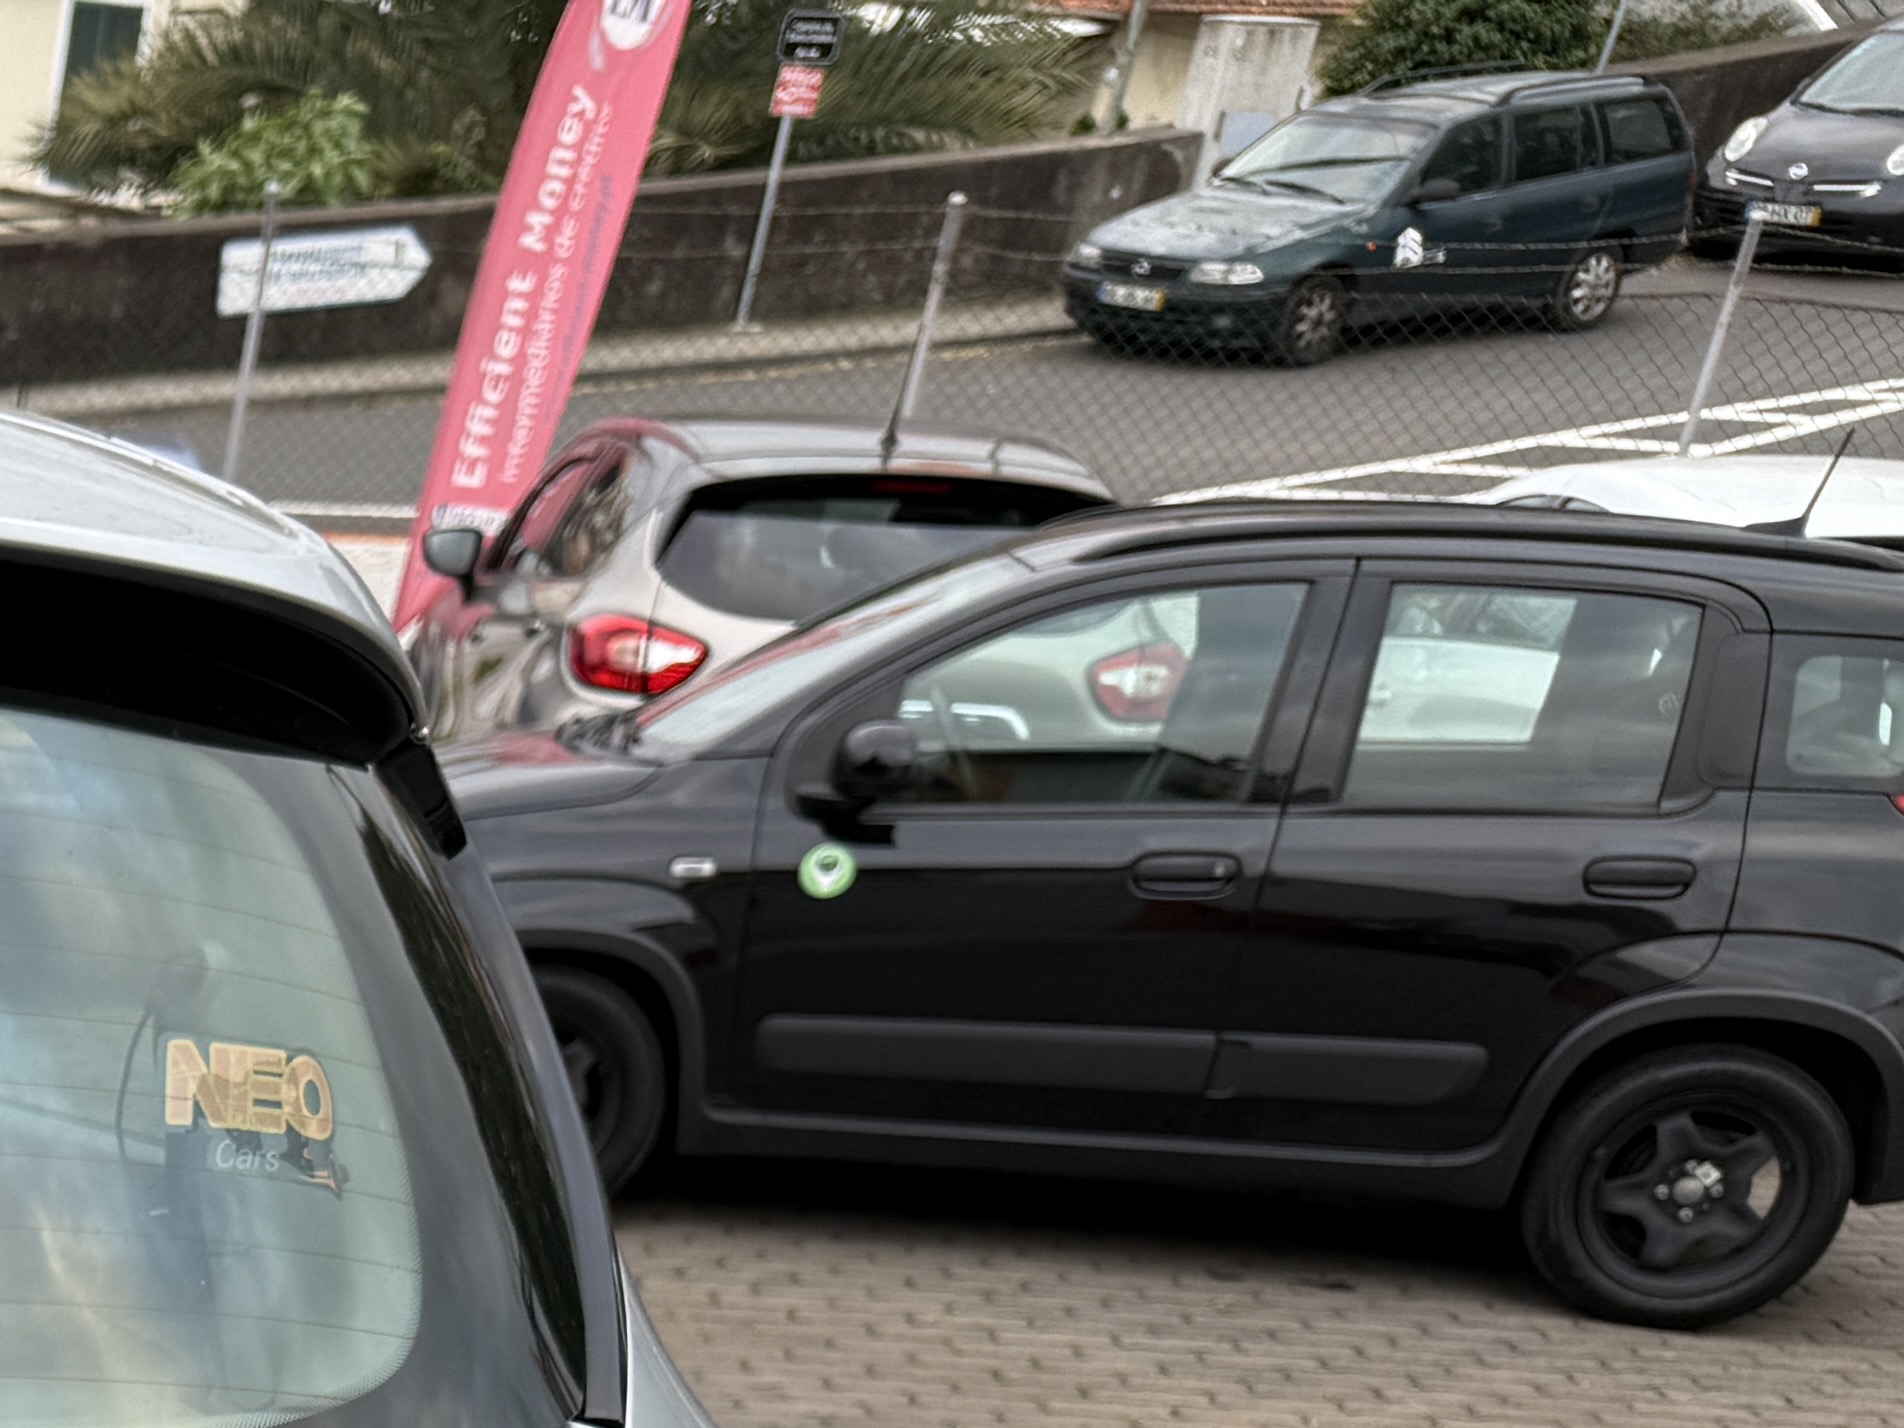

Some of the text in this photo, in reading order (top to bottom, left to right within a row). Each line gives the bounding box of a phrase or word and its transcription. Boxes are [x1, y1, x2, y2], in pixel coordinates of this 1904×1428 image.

[553, 213, 580, 259] de
[450, 269, 539, 489] Efficient
[517, 84, 598, 253] Money
[165, 1039, 334, 1141] NEO
[215, 1140, 279, 1172] Cars
